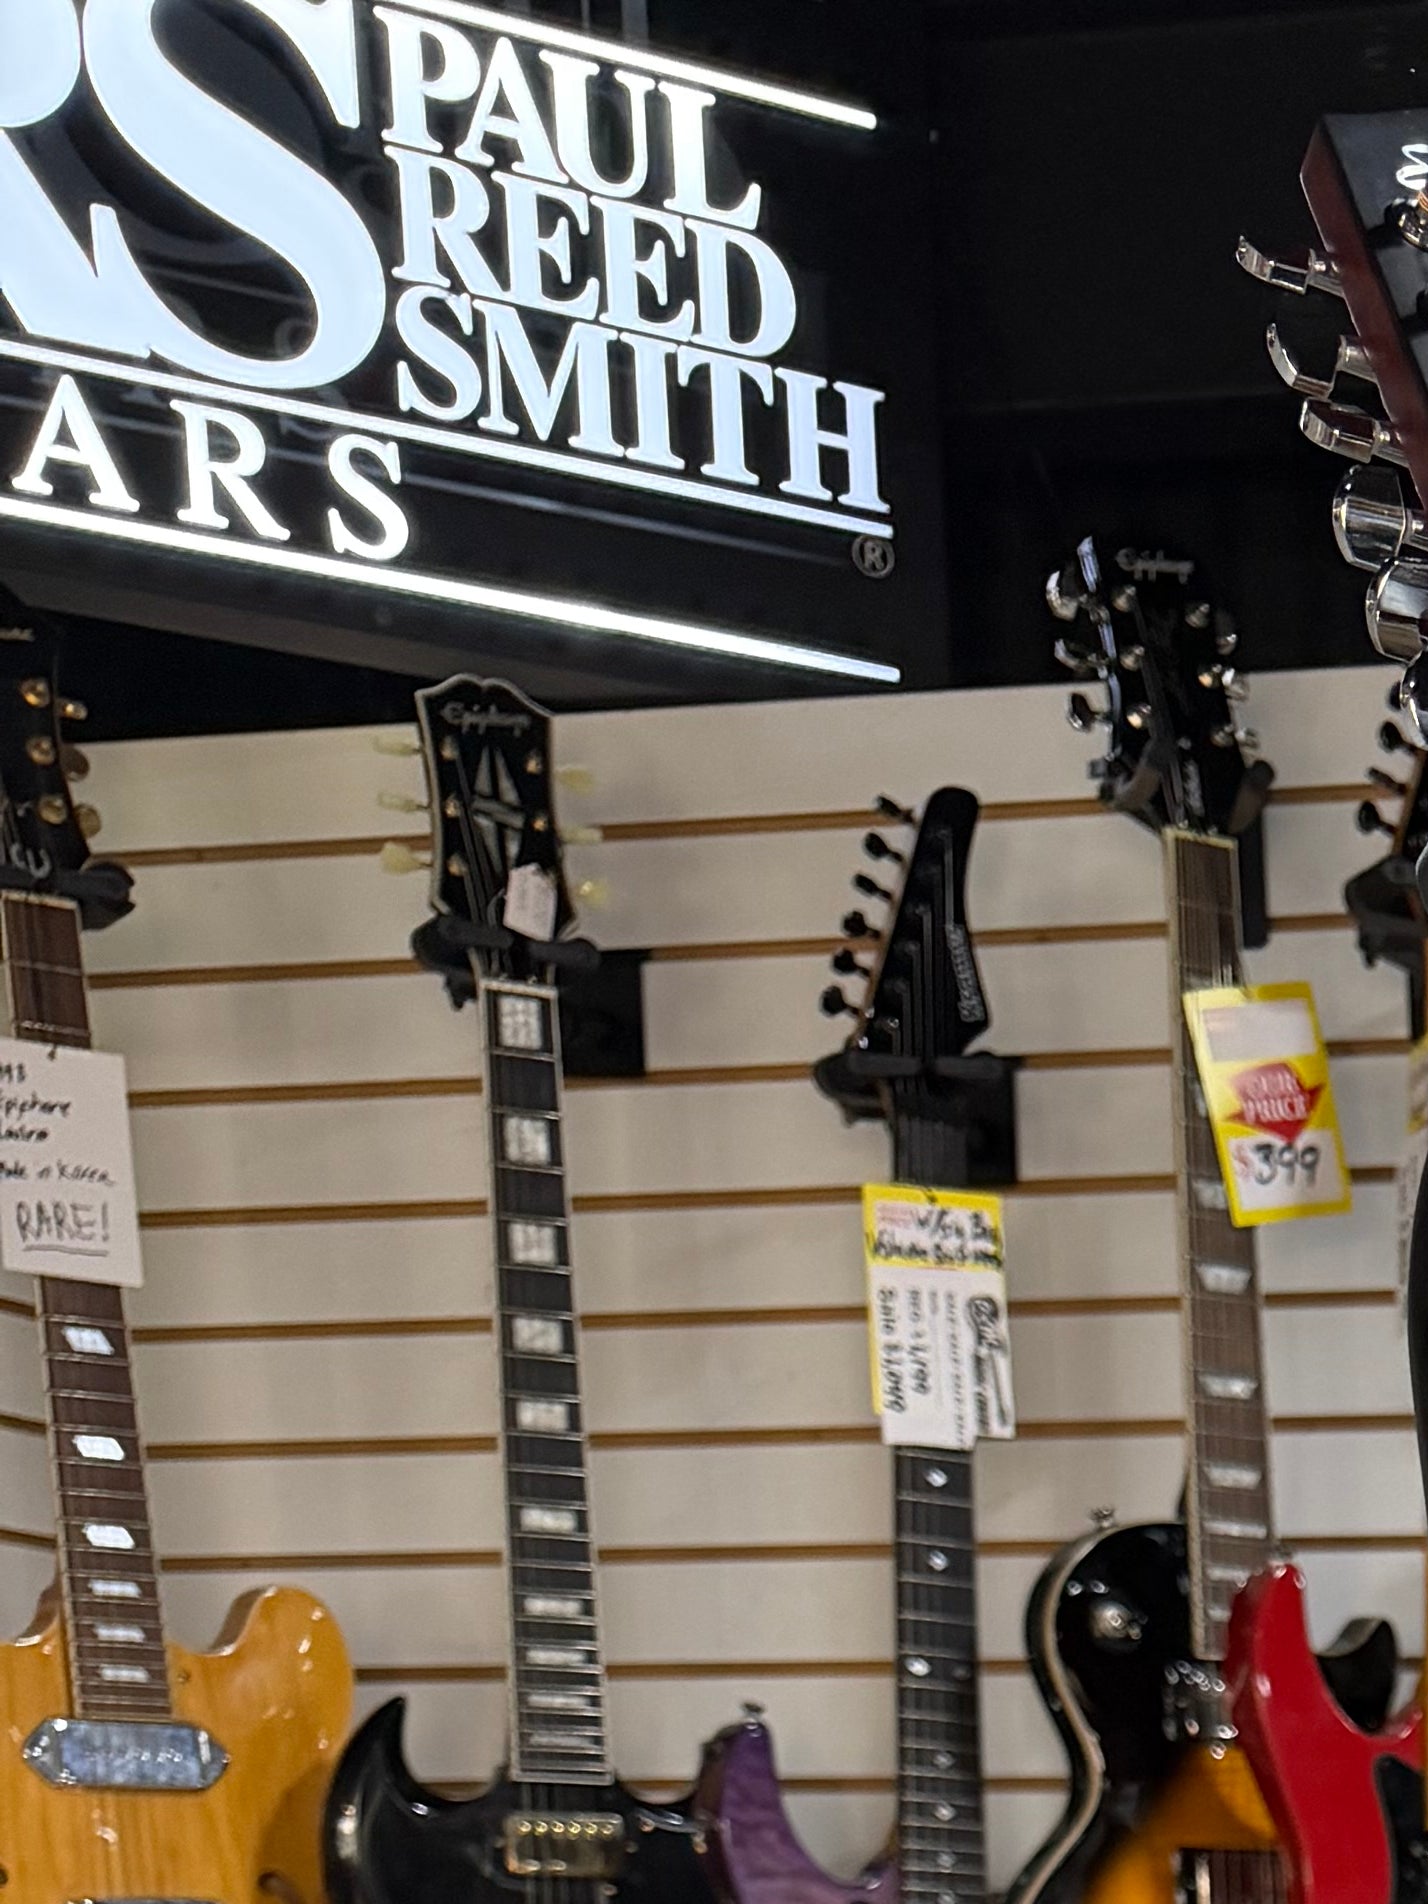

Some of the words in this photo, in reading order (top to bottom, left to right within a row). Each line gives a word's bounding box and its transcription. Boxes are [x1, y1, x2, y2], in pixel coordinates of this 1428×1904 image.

[372, 6, 761, 231] PAUL
[384, 144, 797, 357] REED
[12, 374, 409, 561] ARS
[395, 286, 890, 514] SMITH
[16, 1201, 109, 1243] RARE!
